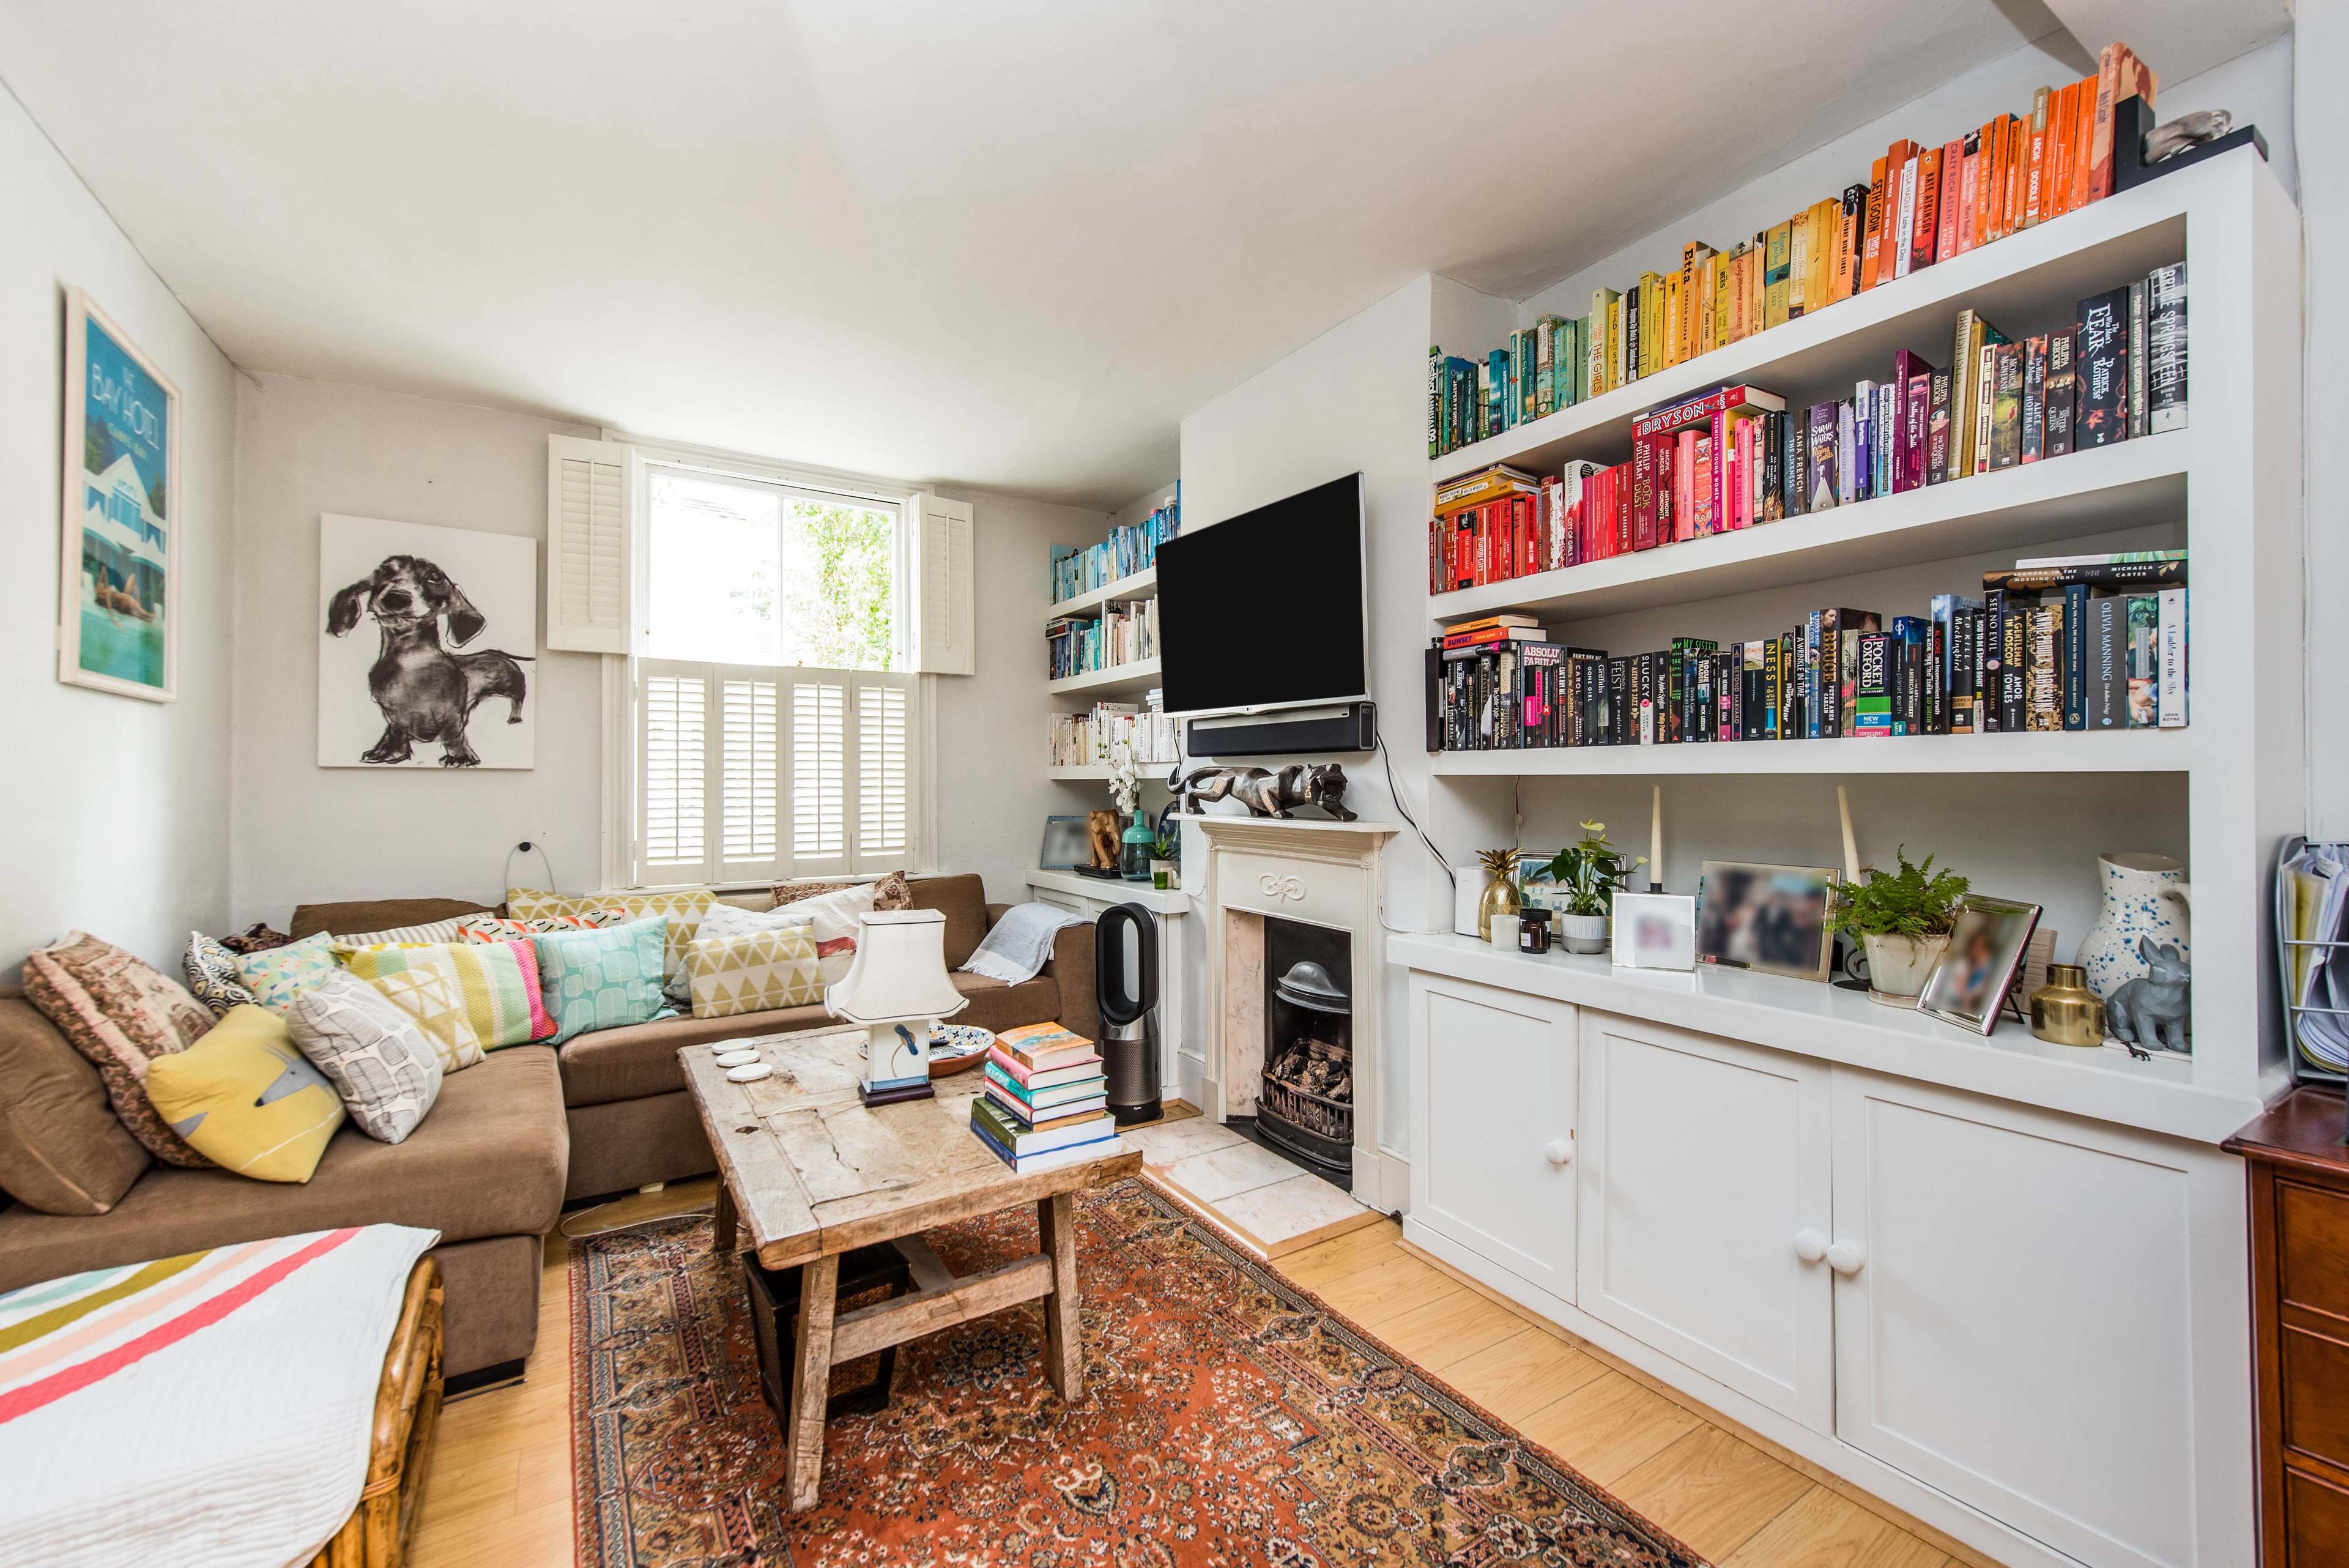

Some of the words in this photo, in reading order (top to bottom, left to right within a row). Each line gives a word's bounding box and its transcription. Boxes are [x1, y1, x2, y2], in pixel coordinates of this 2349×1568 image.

[1949, 144, 1958, 169] CRAZY
[2032, 137, 2041, 163] ARCHI-
[1872, 179, 1883, 202] SETH
[1925, 173, 1934, 192] KATE
[2029, 171, 2039, 202] DOODLE
[1869, 203, 1880, 232] GODIN
[1923, 196, 1932, 234] ATKINSON
[1871, 236, 1880, 250] THIS
[2161, 269, 2175, 308] BRUCE
[2088, 303, 2110, 359] FEAR
[2134, 324, 2143, 347] HISTORY
[2052, 338, 2061, 370] GREGORY
[2061, 336, 2070, 367] PHILIPPA
[2134, 357, 2142, 367] THE
[2160, 311, 2175, 385] SPRINGSTEEN
[2026, 366, 2035, 384] Magic
[2093, 357, 2106, 399] ROTHFUSS
[2101, 357, 2115, 393] PATRICK
[2134, 368, 2142, 392] MODERN
[92, 363, 122, 414] BAY
[124, 391, 160, 450] HOTEL
[1642, 402, 1704, 435] BRYSON
[1910, 401, 1918, 418] Valley
[2134, 393, 2143, 415] WORLD
[1429, 429, 1436, 442] 09
[1811, 431, 1833, 448] WATERS
[1812, 422, 1832, 437] SARAH
[1965, 616, 1971, 628] TO
[1989, 615, 1997, 628] NO
[2005, 619, 2013, 628] IN
[2102, 603, 2112, 634] OLIVIA
[1683, 639, 1693, 648] MY
[1696, 641, 1716, 650] SISTER
[1823, 631, 1836, 683] BRUCE
[1953, 617, 1962, 671] Mockingbird
[2005, 630, 2013, 665] MOSCOW
[2102, 635, 2112, 680] MANNING
[2167, 631, 2176, 656] Ladder
[1611, 661, 1622, 692] FEIST
[1766, 646, 1776, 680] NESS
[1862, 641, 1873, 688] OXFORD
[1872, 641, 1883, 684] POCKET
[2004, 673, 2013, 704] TOWLES
[2165, 682, 2176, 695] Sky
[985, 1063, 1009, 1087] MAGPIE
